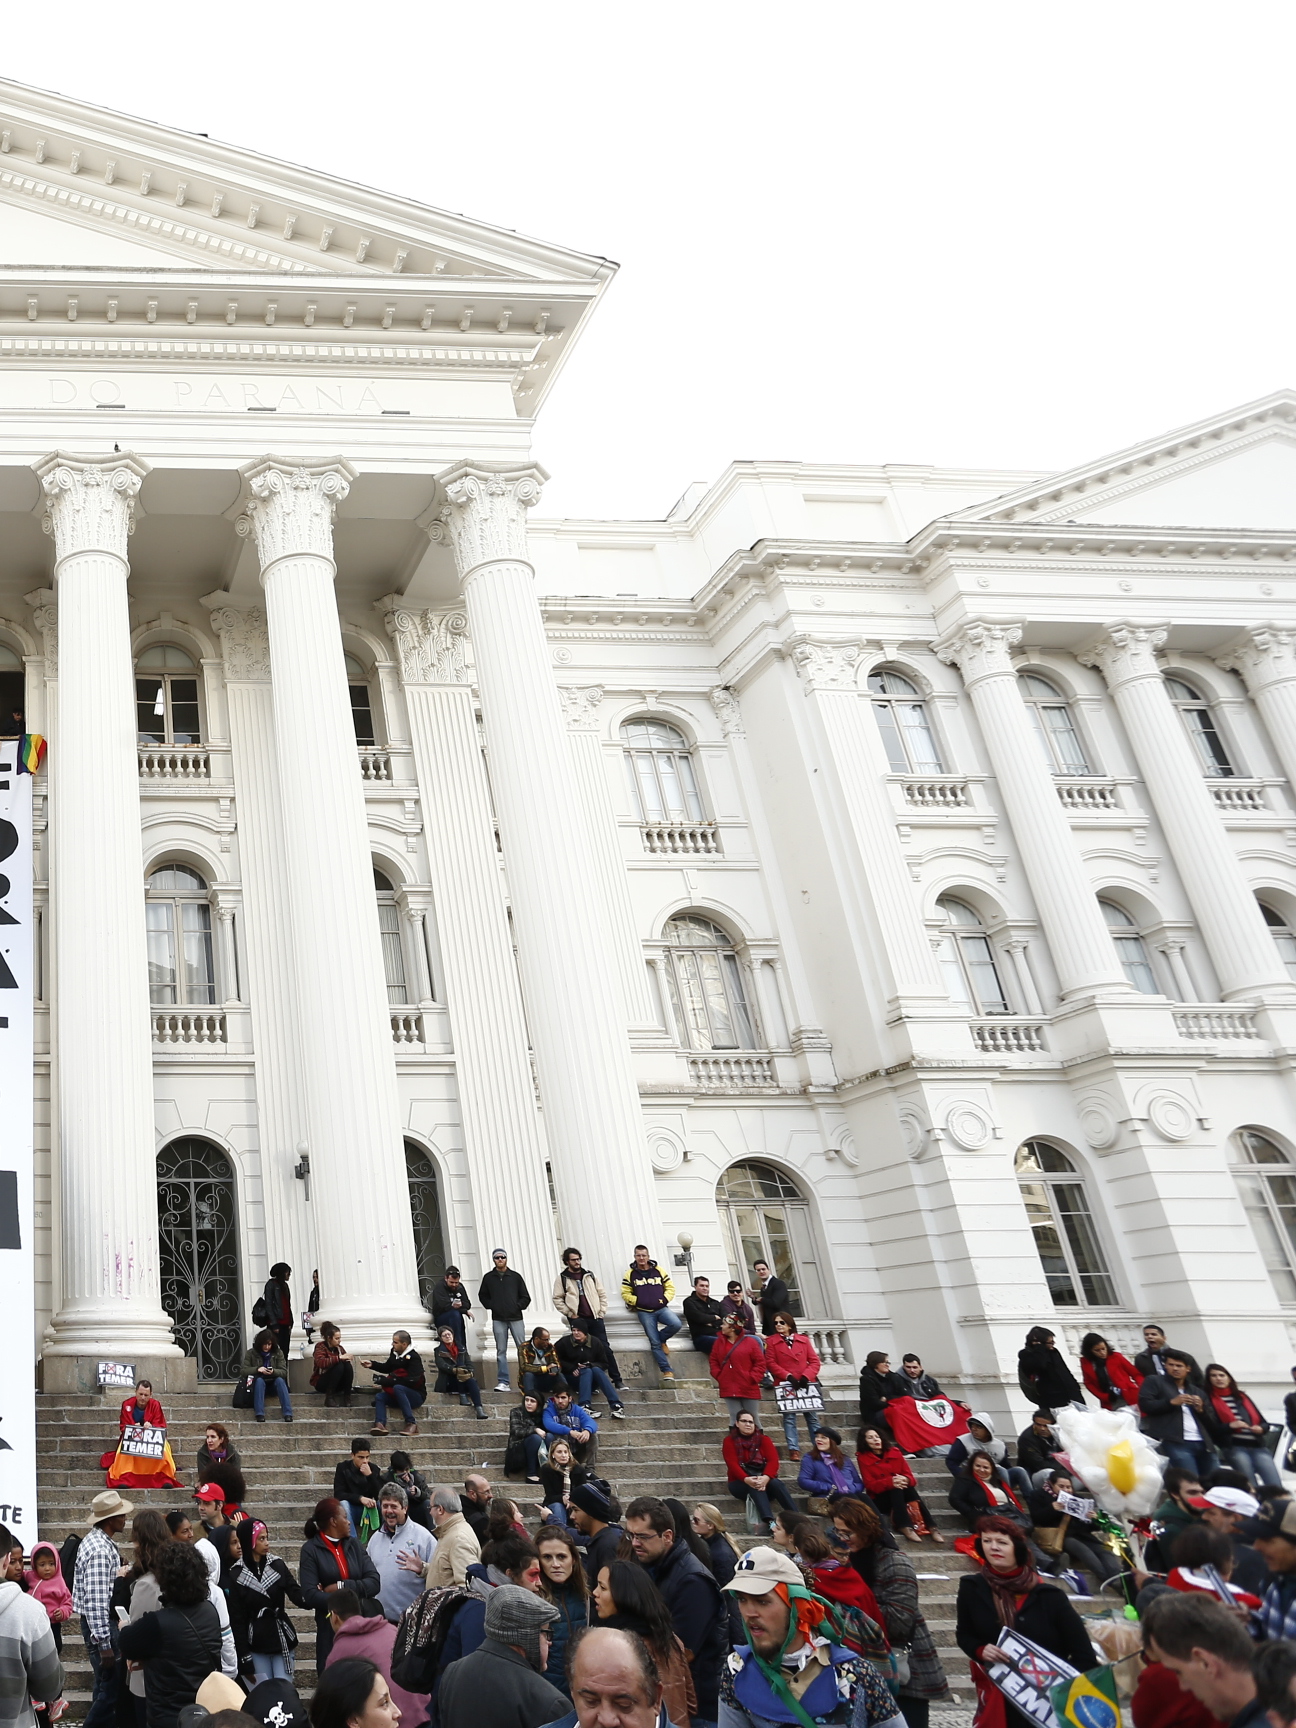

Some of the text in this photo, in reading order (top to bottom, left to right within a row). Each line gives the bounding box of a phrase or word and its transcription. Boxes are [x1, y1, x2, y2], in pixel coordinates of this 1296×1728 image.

[48, 378, 122, 405] DO
[173, 380, 386, 411] PARANÁ
[98, 1363, 134, 1377] FORA
[98, 1374, 135, 1386] TEMER
[775, 1385, 821, 1400] FORA
[777, 1397, 824, 1411] TEMER
[123, 1427, 164, 1444] FORA
[122, 1440, 163, 1456] TEMER
